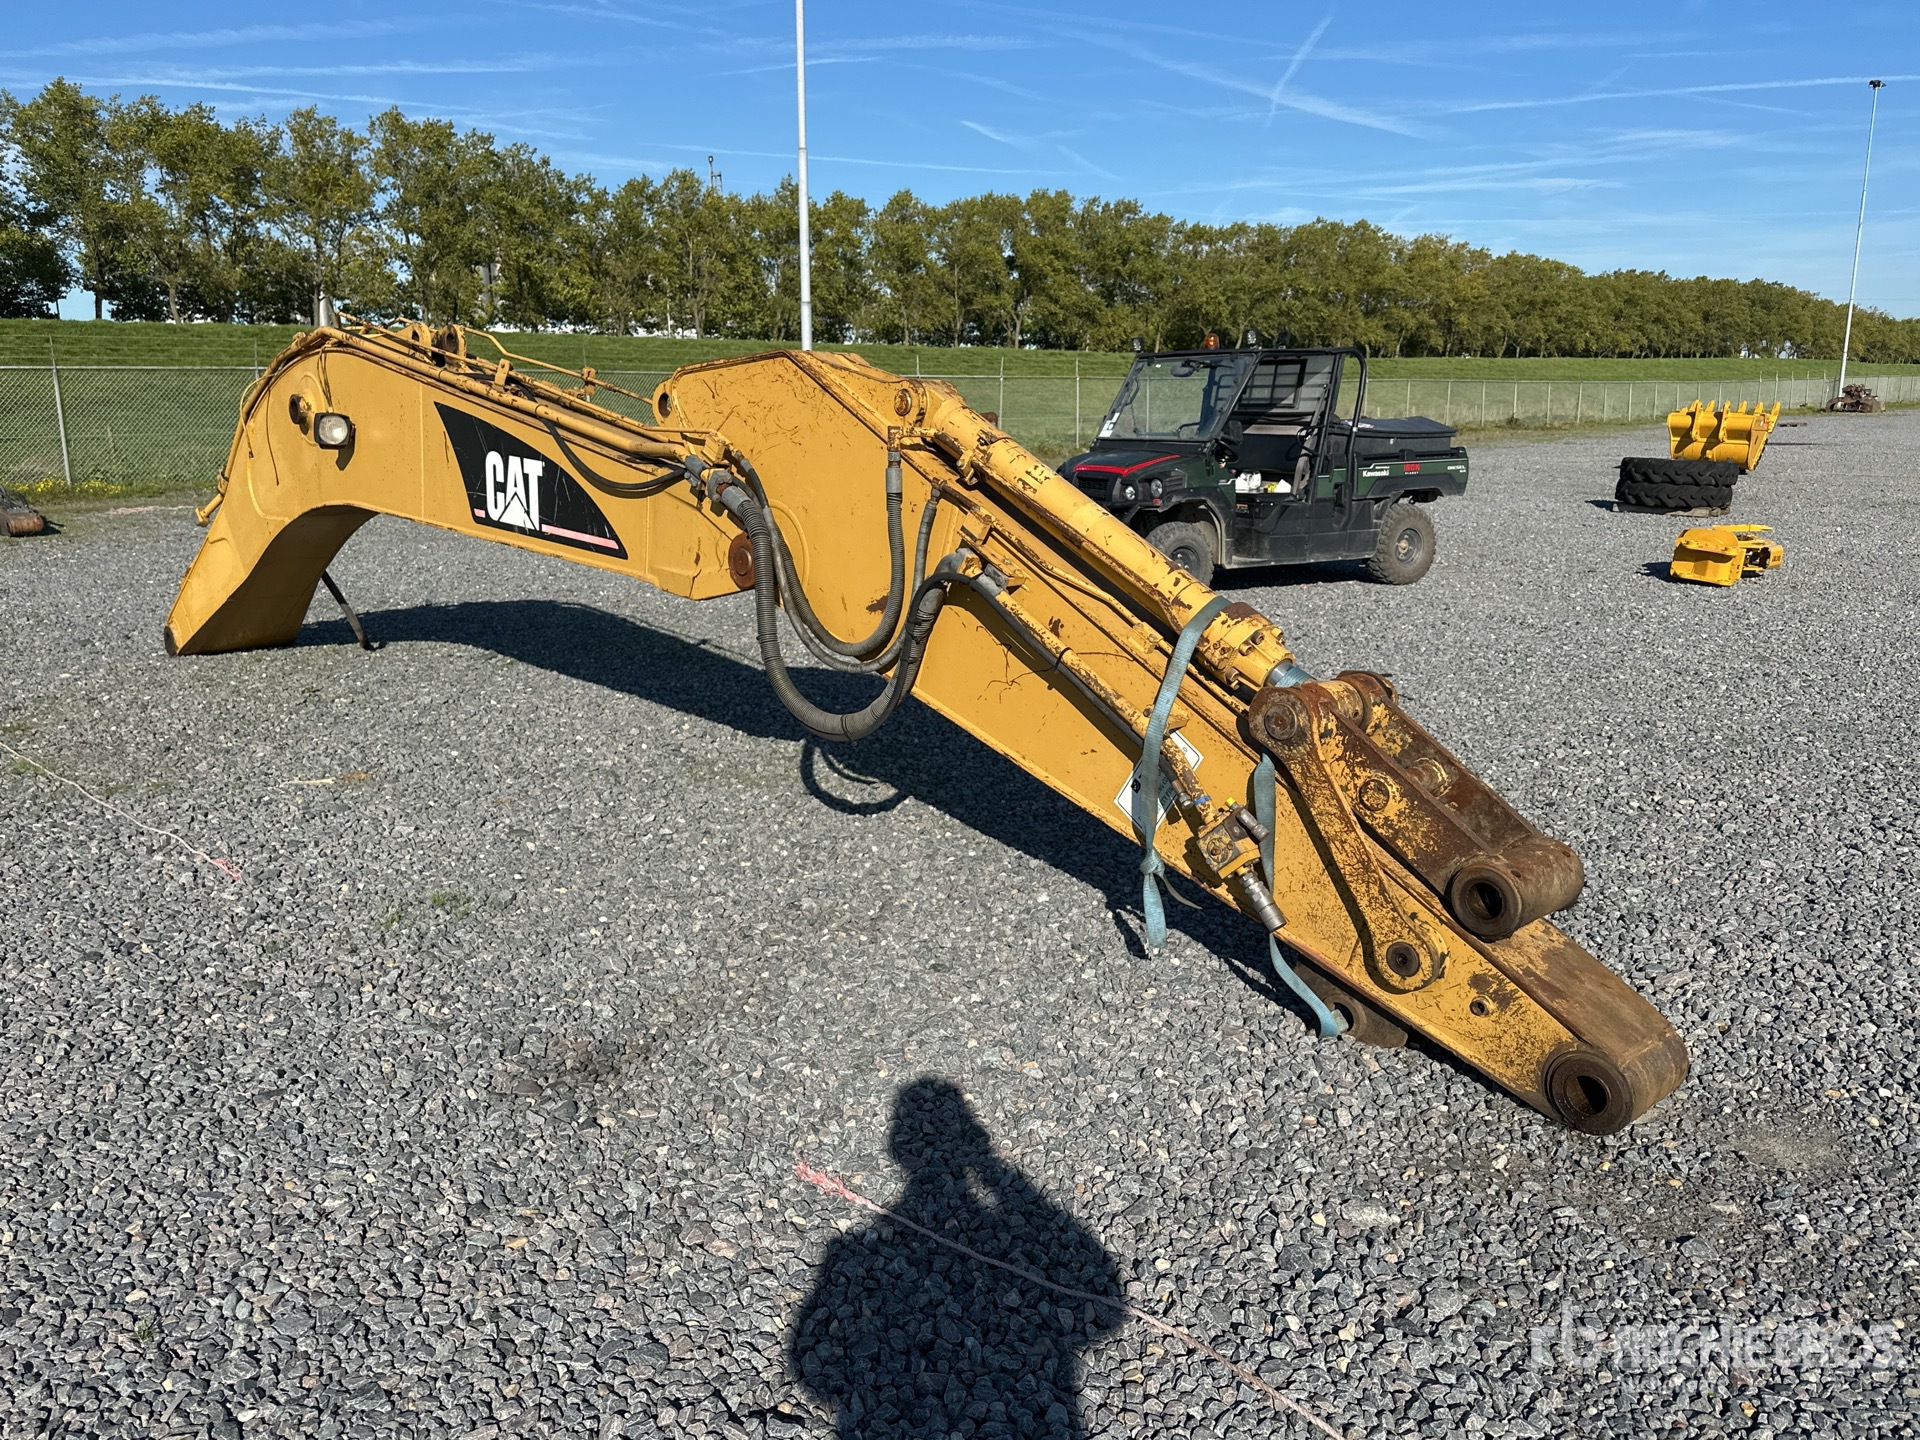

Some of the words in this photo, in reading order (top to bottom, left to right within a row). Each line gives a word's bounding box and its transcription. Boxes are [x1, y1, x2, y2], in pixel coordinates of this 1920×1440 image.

[1403, 463, 1420, 472] IRON
[1362, 469, 1390, 477] Kawasaki
[485, 450, 543, 531] CAT
